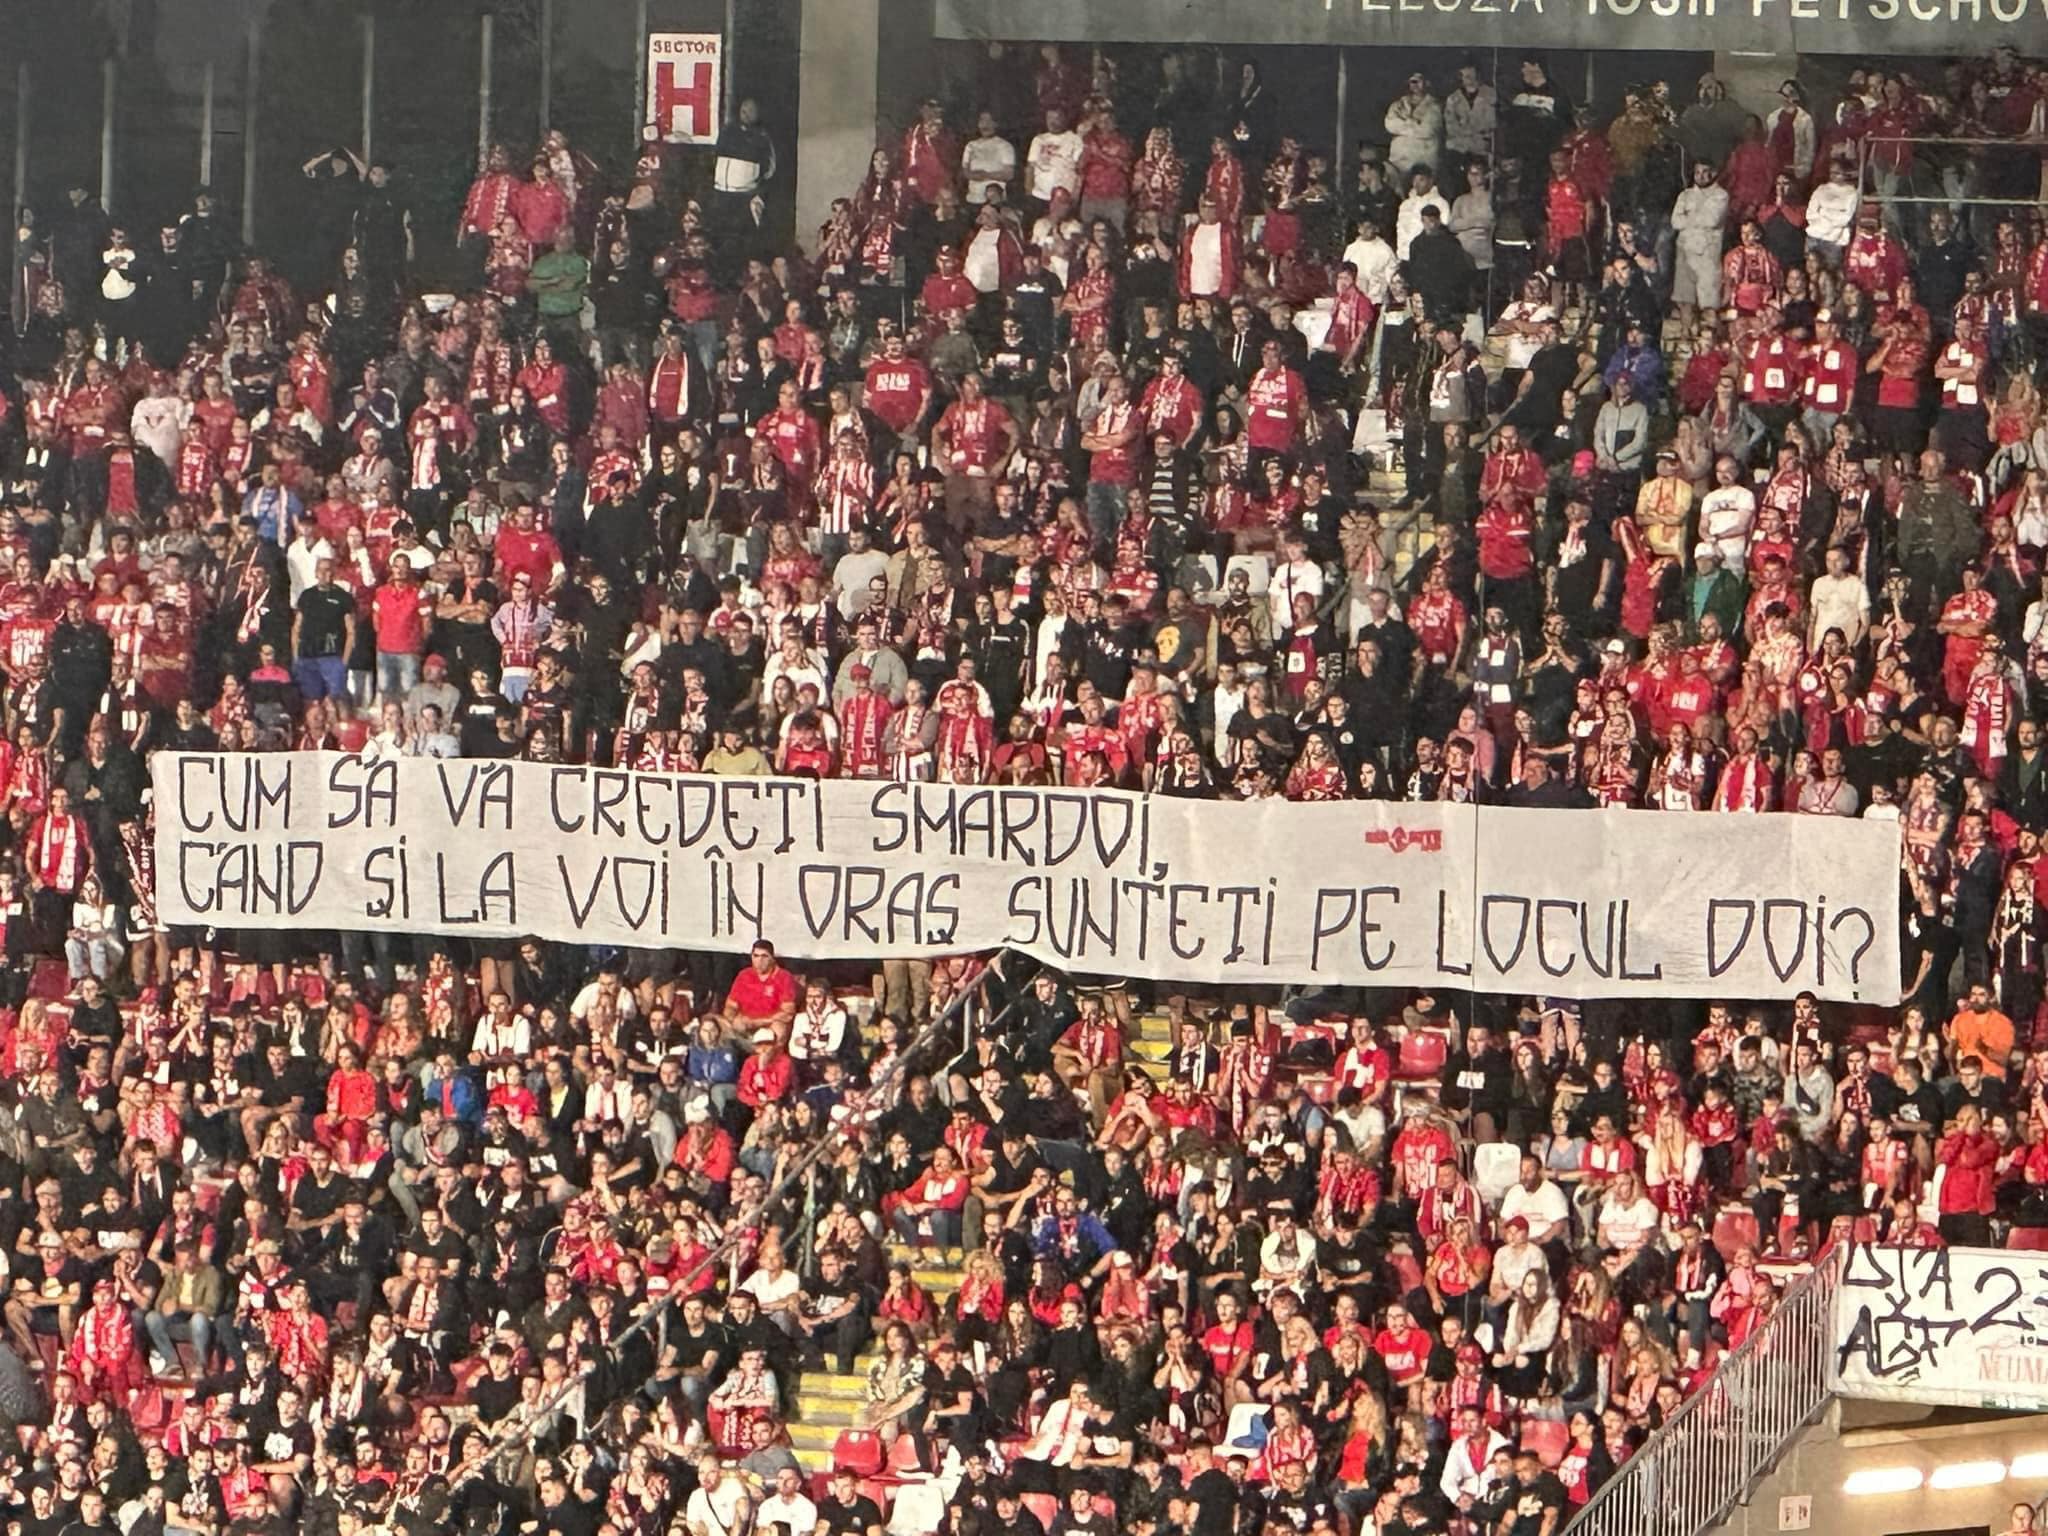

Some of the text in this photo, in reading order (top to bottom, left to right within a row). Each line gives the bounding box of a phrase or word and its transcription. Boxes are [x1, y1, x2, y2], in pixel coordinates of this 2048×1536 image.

[653, 39, 716, 54] SECTOR
[656, 61, 712, 136] H
[178, 756, 292, 832] CUM
[437, 850, 516, 924] LA
[703, 844, 765, 940] ÎN
[1310, 885, 1400, 972] PE
[1436, 889, 1662, 980] LOCUL
